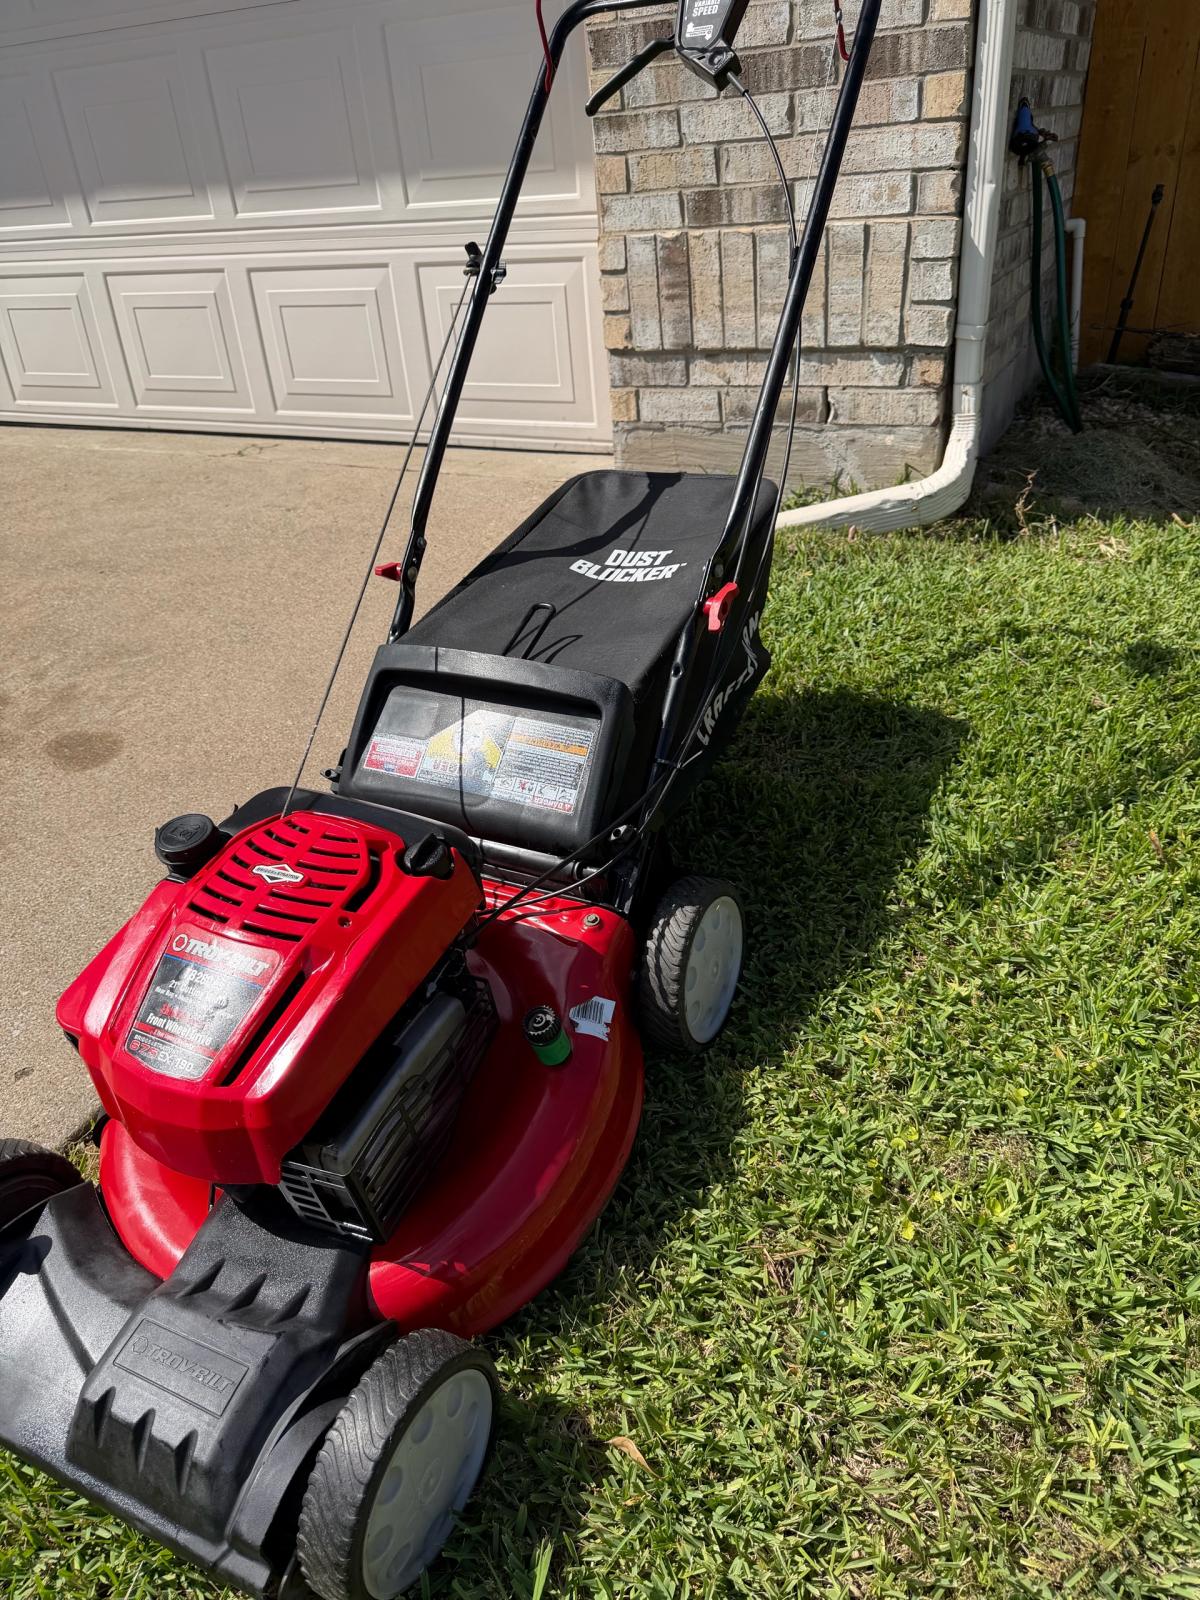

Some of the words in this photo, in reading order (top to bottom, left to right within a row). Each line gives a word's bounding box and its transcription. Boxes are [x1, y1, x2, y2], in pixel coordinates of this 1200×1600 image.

[692, 5, 718, 17] SPEED
[604, 549, 674, 567] DUST
[569, 559, 681, 582] BLOCKER
[145, 1012, 167, 1029] Front
[164, 1019, 191, 1038] Wheel
